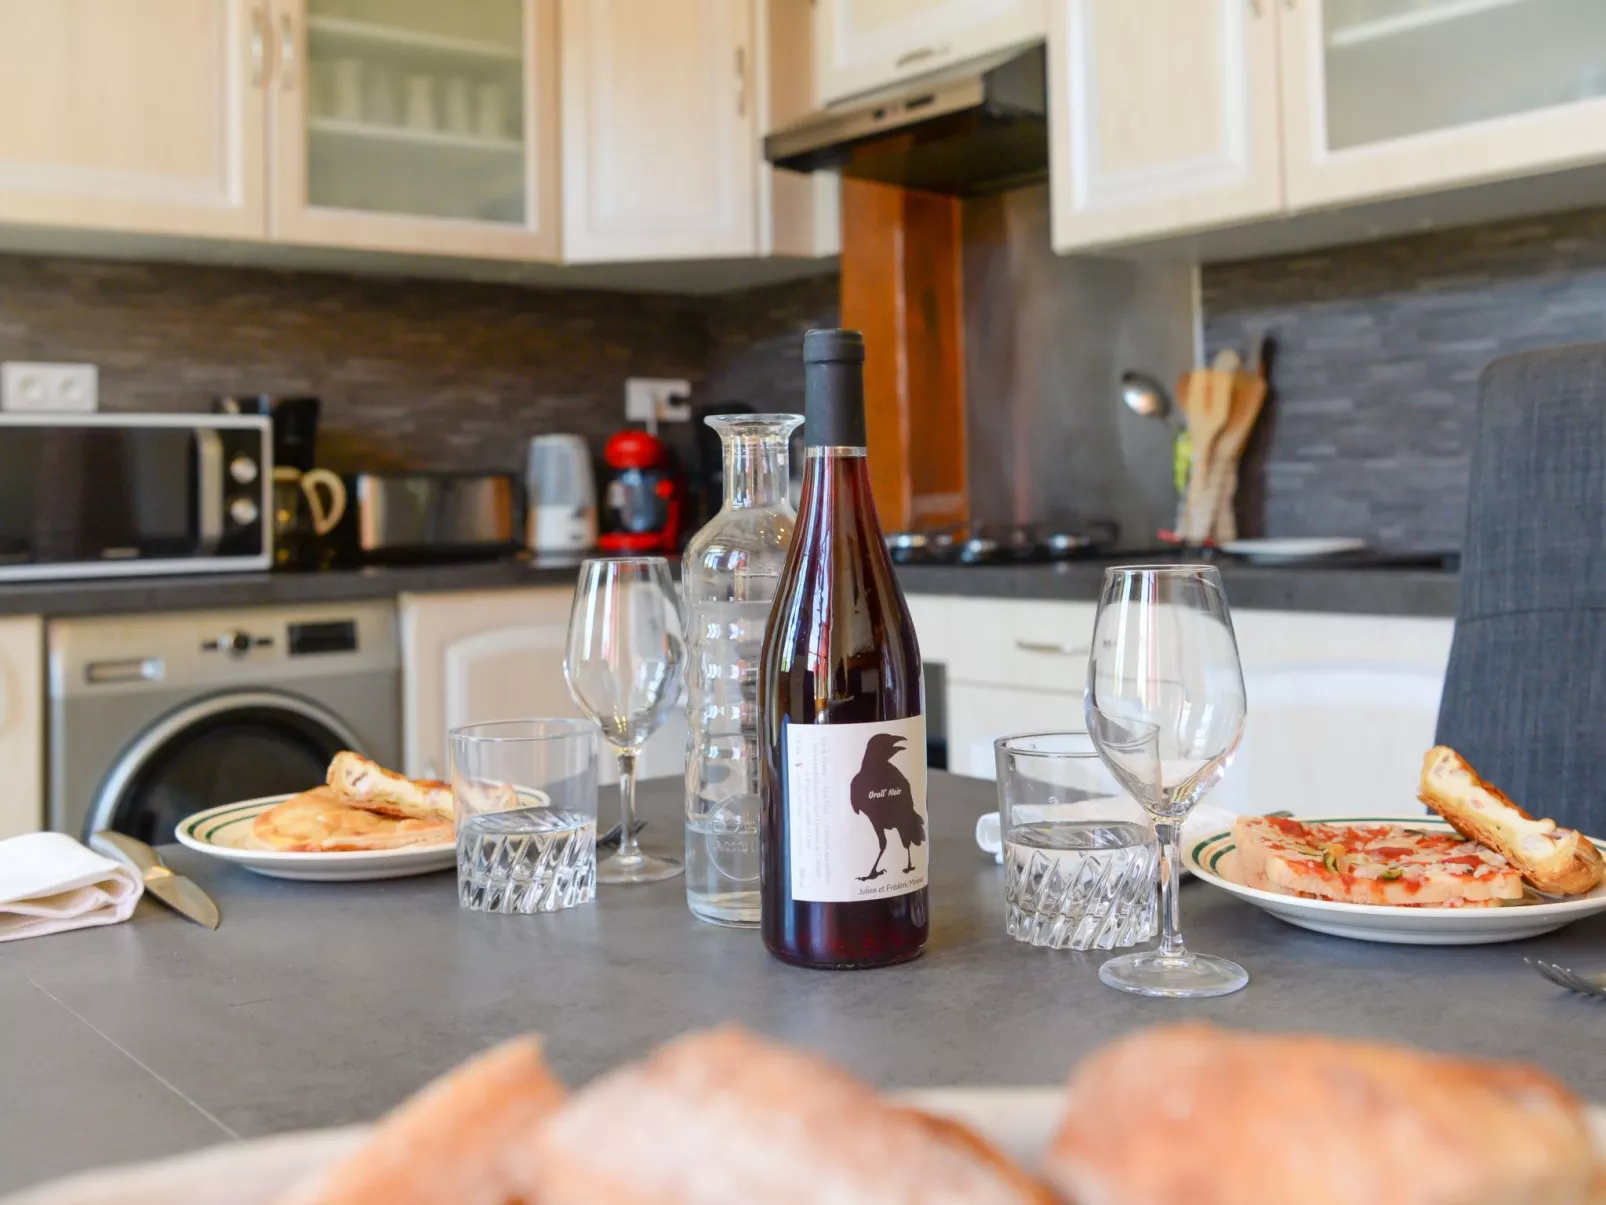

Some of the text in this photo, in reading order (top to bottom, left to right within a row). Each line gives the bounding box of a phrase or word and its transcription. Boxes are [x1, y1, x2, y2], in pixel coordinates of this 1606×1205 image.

[887, 787, 902, 797] Noir
[858, 886, 877, 896] Julien
[878, 885, 885, 893] et
